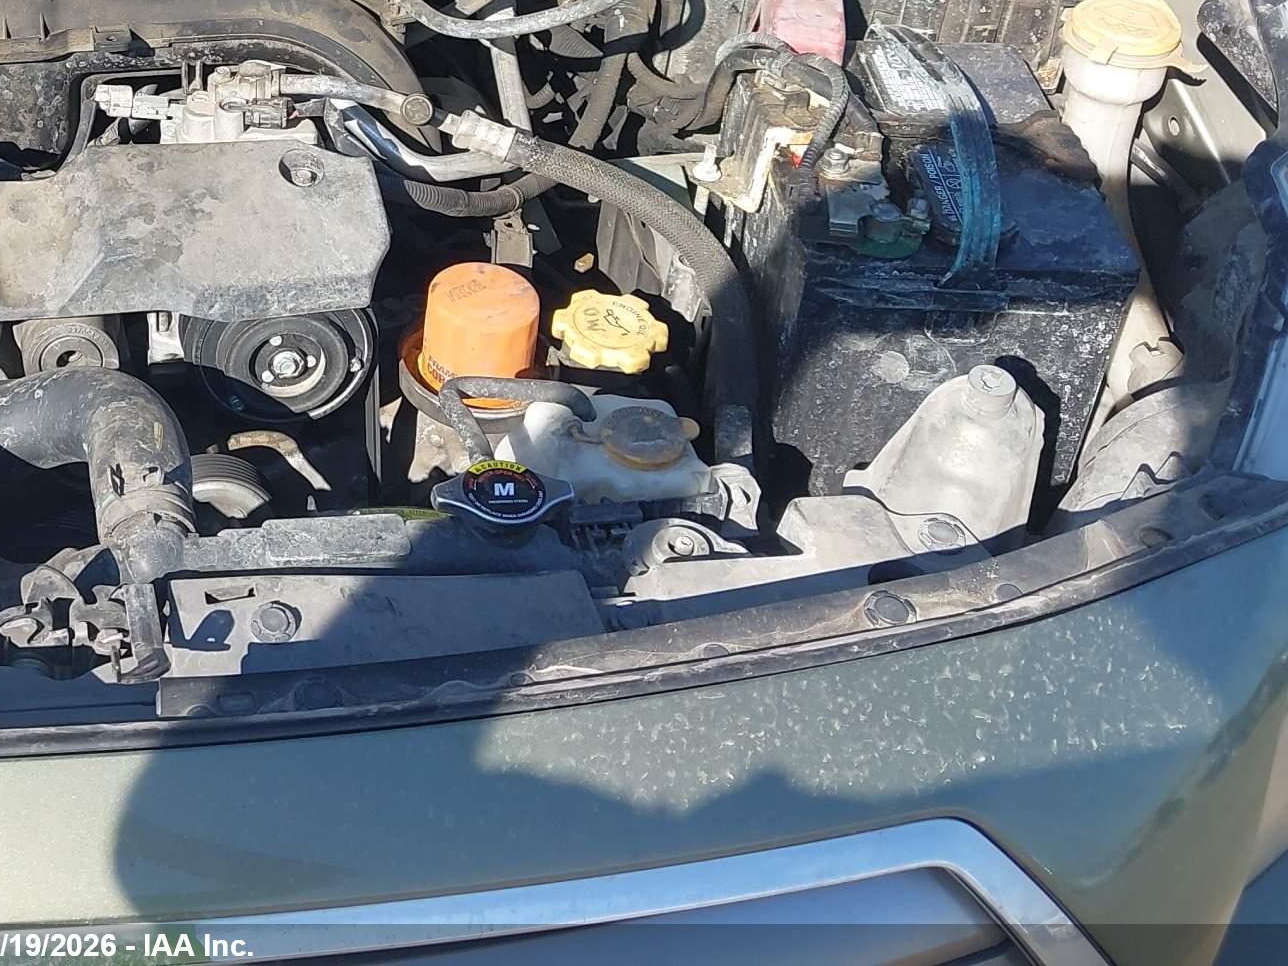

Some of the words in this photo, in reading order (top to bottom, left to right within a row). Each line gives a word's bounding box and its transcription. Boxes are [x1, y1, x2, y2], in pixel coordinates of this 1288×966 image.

[920, 153, 939, 179] POISON
[934, 185, 957, 215] DANGER
[483, 461, 523, 471] CAUTION
[494, 482, 515, 496] M
